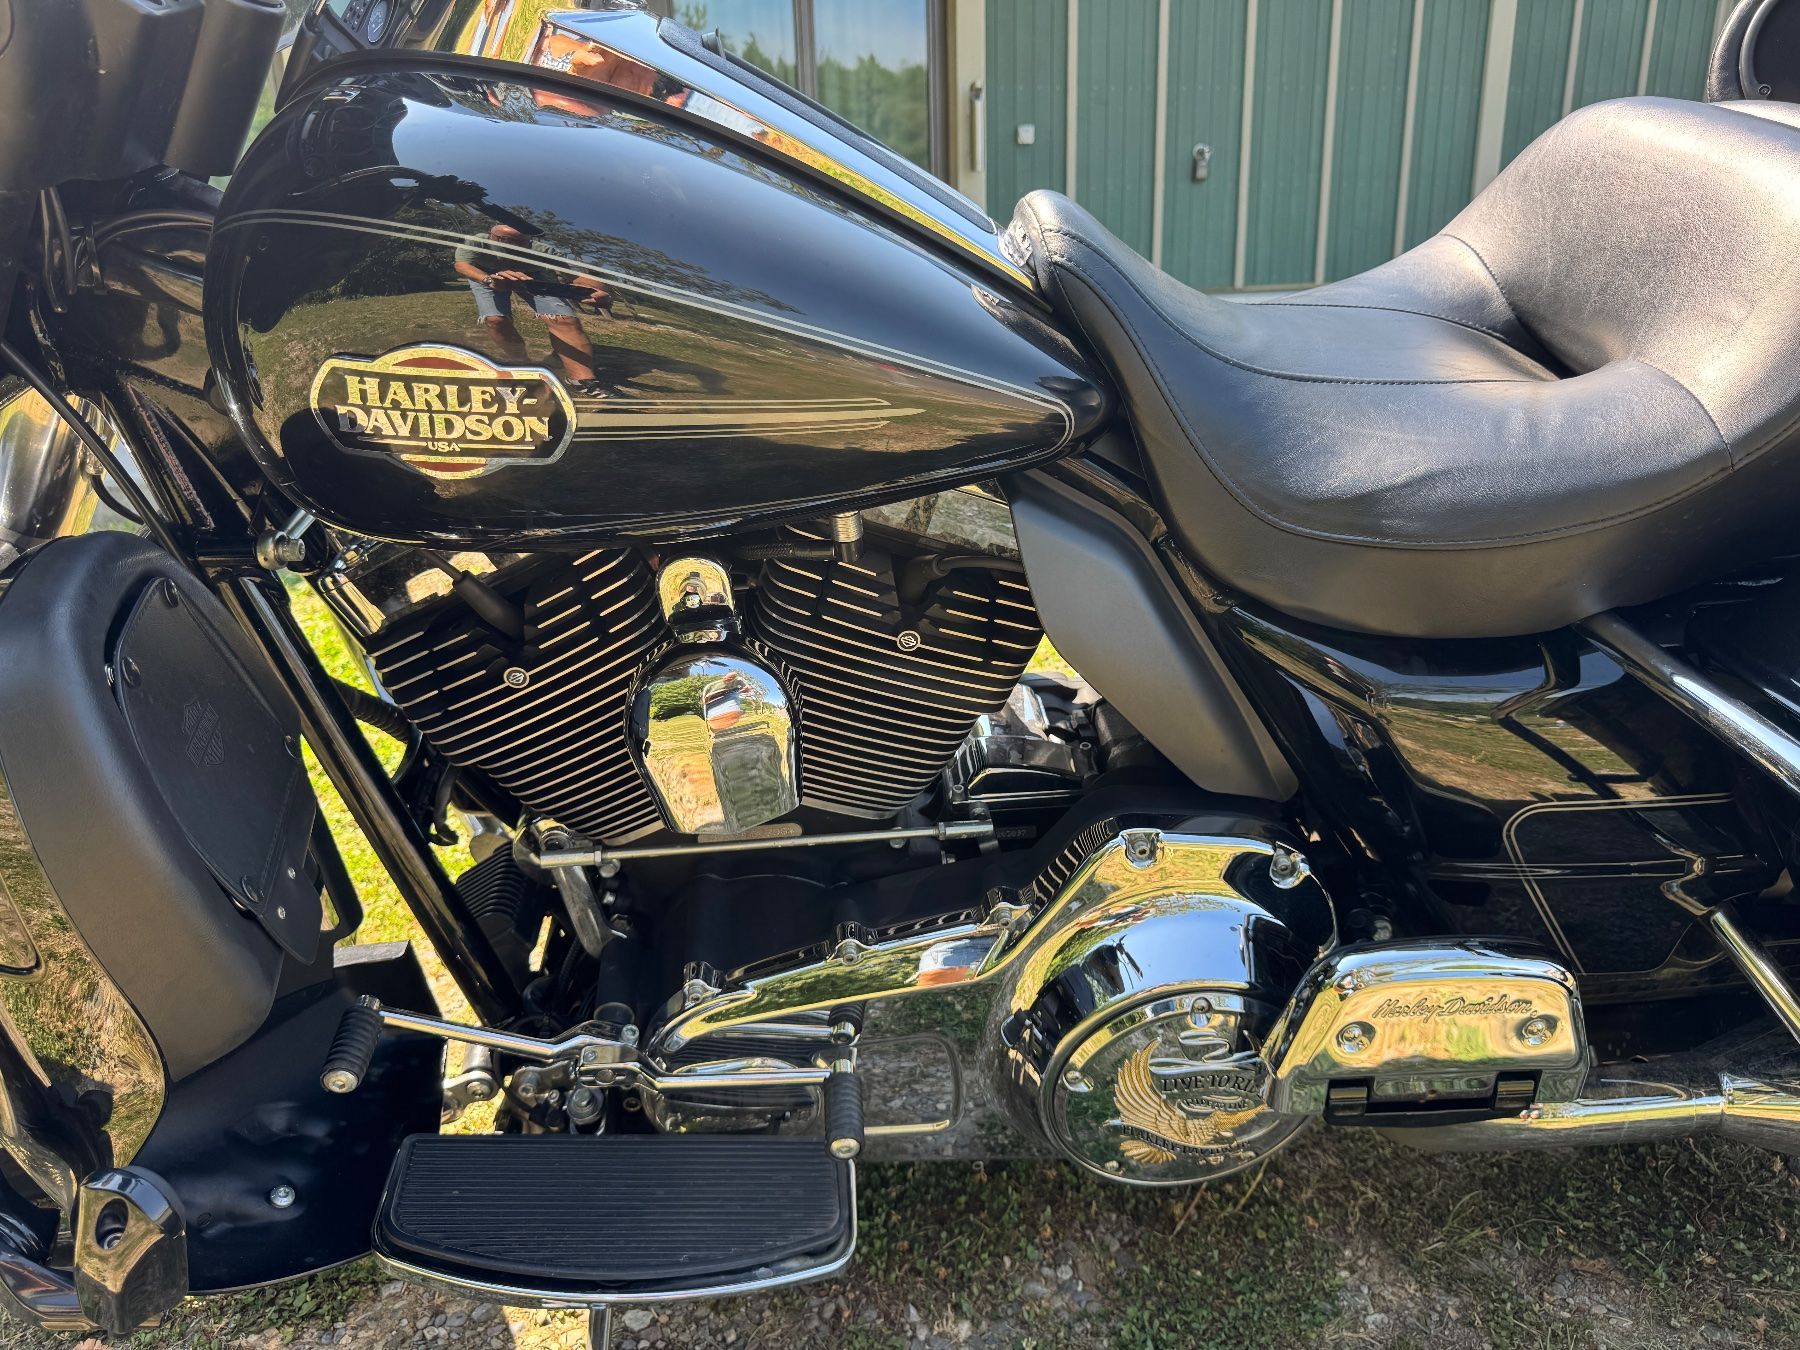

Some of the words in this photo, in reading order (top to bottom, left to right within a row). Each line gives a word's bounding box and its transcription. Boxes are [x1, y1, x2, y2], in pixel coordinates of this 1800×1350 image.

[345, 374, 538, 414] HARLEY-
[335, 404, 550, 442] DAVIDSON
[428, 441, 461, 452] USA
[1162, 1075, 1205, 1093] LIVE
[1207, 1074, 1230, 1089] TO
